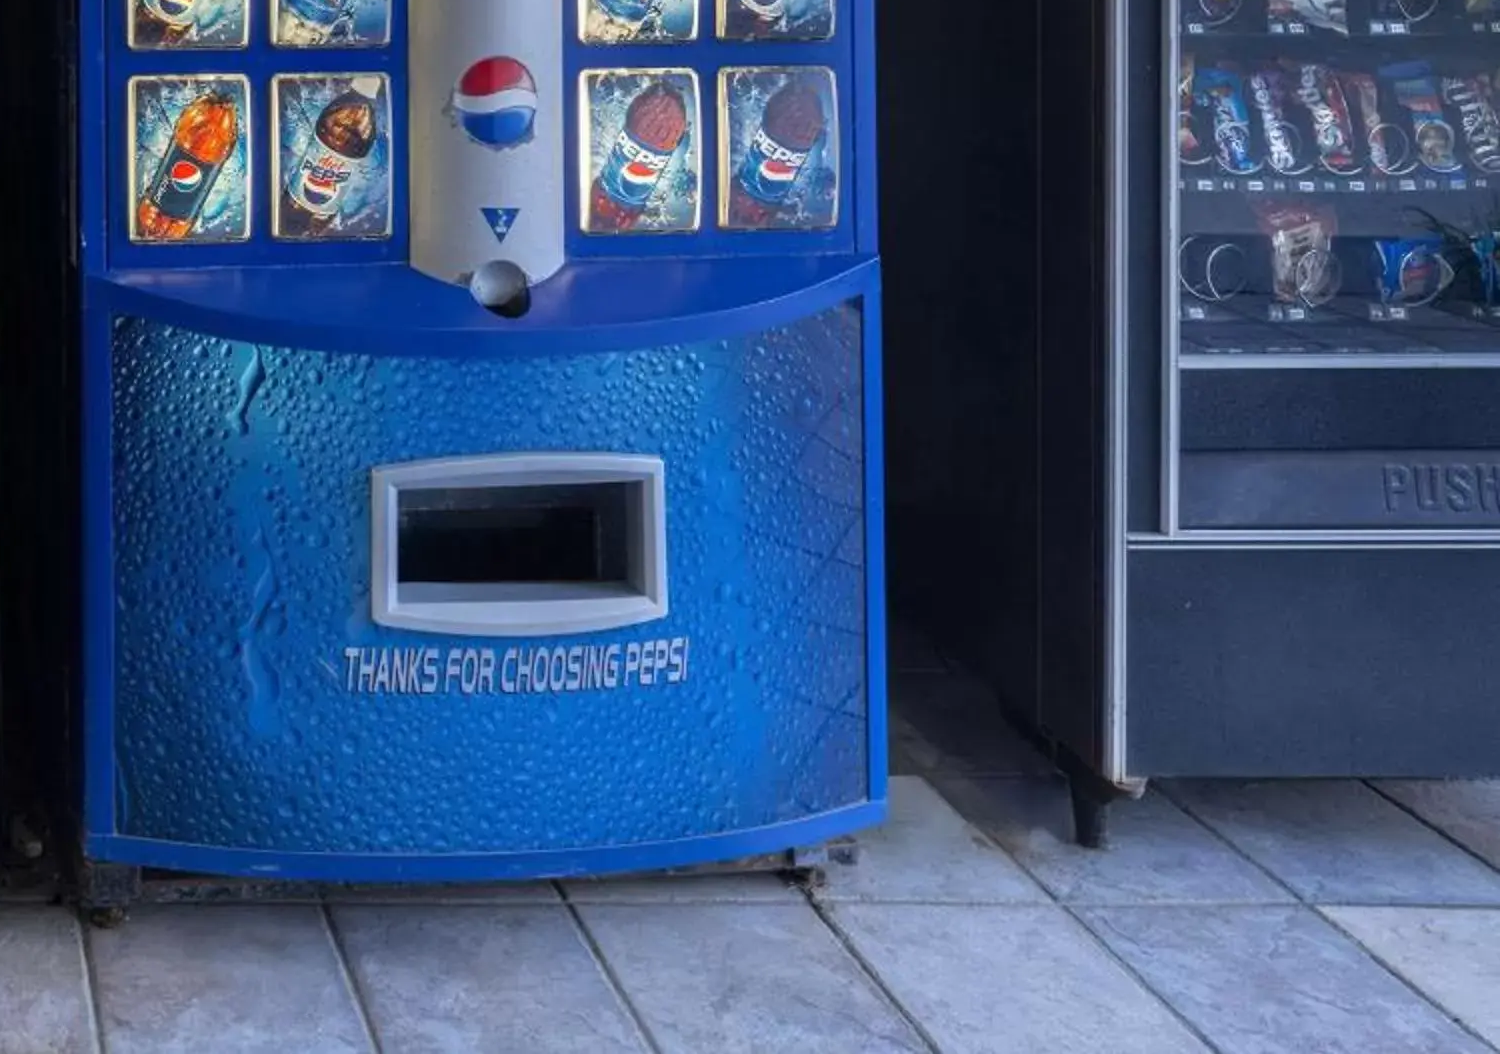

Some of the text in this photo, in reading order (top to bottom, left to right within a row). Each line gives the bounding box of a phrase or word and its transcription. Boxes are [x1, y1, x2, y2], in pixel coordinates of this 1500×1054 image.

[344, 637, 690, 694] THANKS FOR CHOOSING PEPSI
